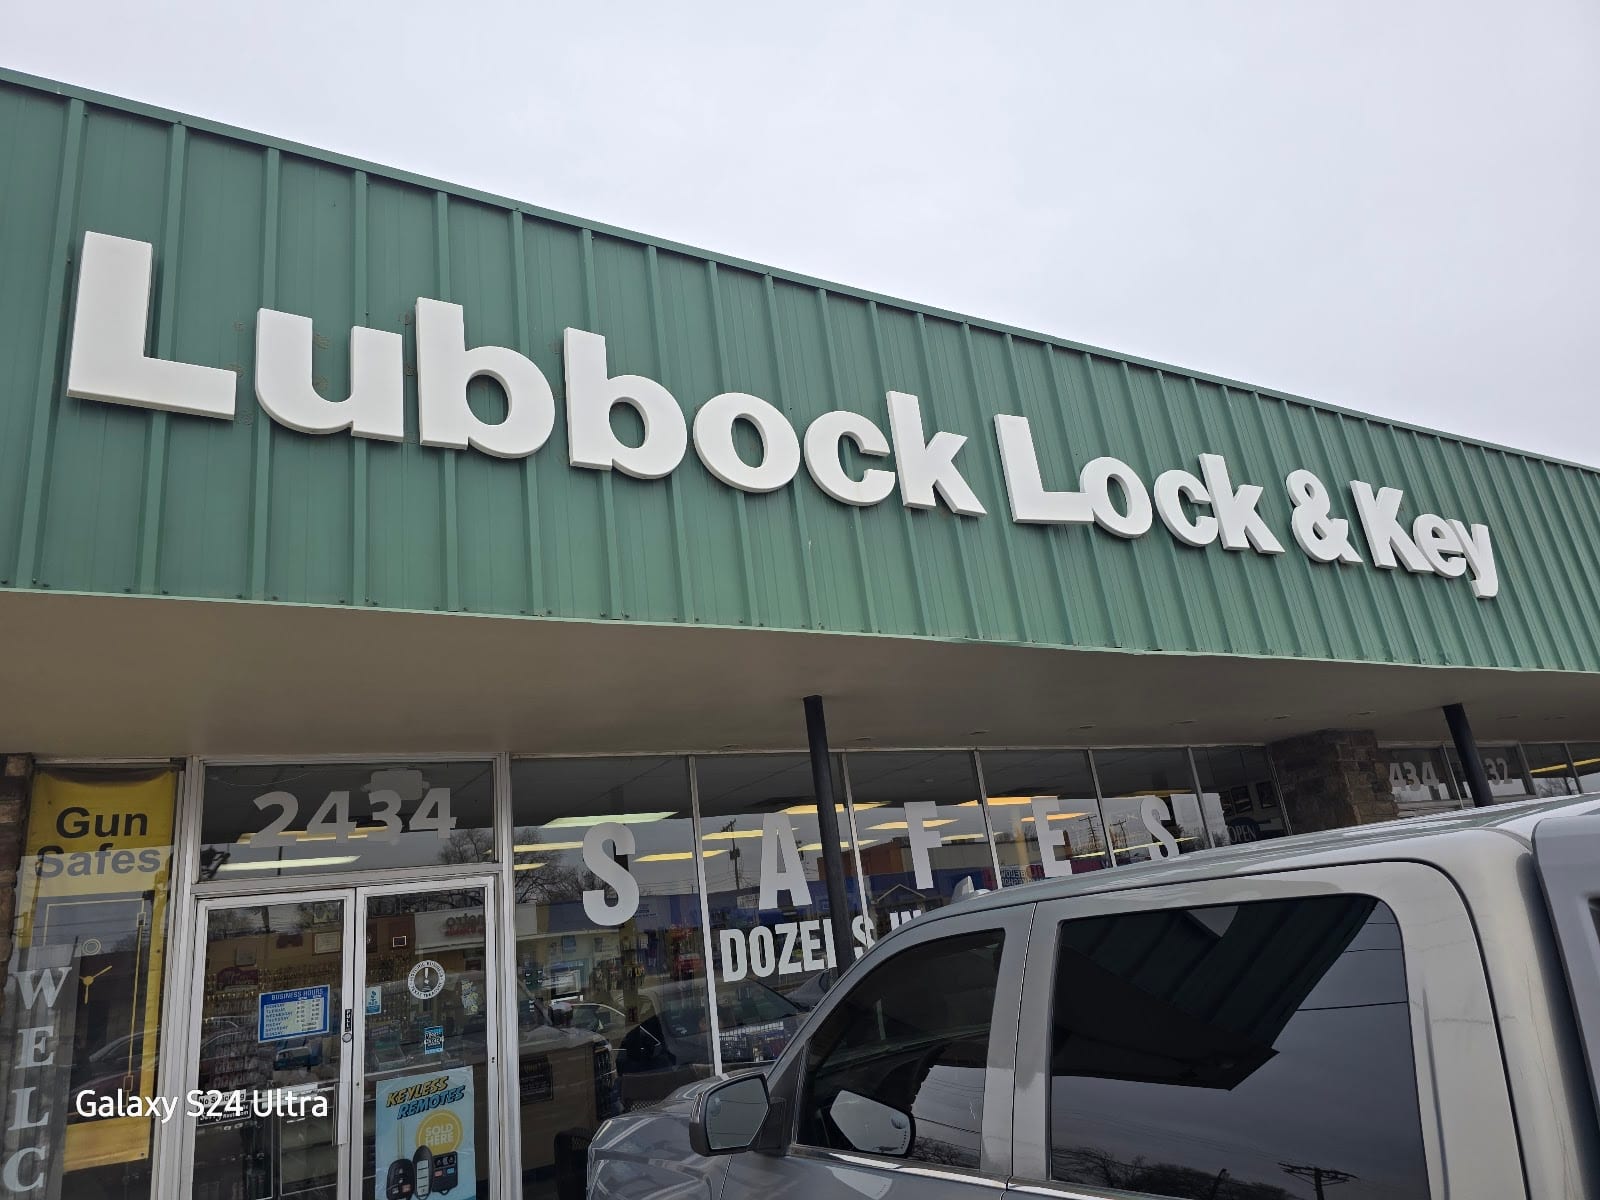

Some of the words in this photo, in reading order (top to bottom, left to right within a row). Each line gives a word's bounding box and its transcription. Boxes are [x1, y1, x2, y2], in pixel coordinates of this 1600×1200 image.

[66, 230, 987, 517] Lubbock
[994, 413, 1286, 556] Lock
[1285, 469, 1363, 564] &
[1349, 480, 1499, 600] Key
[56, 806, 148, 839] Gun
[250, 787, 458, 848] 2434
[36, 843, 161, 878] Safes
[271, 991, 302, 1000] BUSINESS
[303, 988, 324, 998] HOURS
[385, 1076, 449, 1108] KEYLESS
[396, 1085, 466, 1120] REMOTES
[425, 1123, 454, 1137] SOLD
[425, 1133, 454, 1147] HERE
